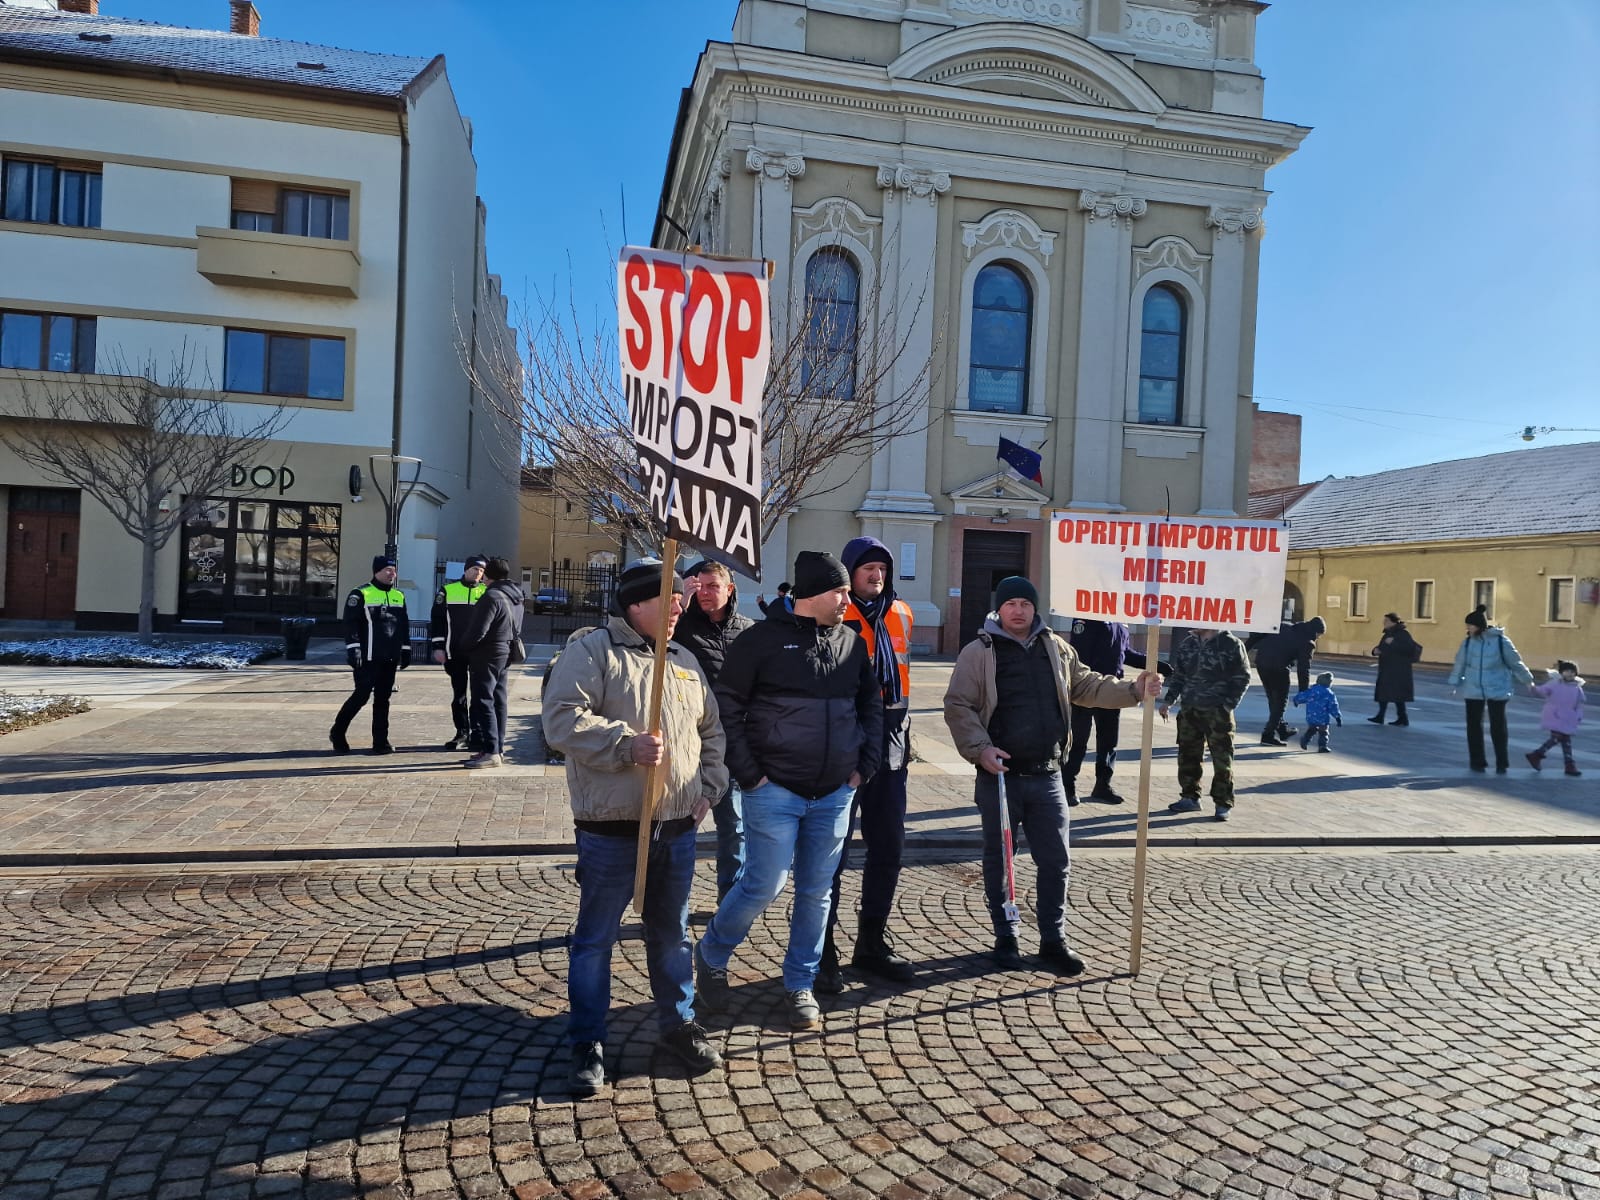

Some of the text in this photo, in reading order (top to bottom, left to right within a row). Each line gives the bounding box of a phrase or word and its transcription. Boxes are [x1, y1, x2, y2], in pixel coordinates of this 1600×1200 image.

[625, 254, 762, 404] STOP
[625, 373, 758, 487] IMPORT
[231, 463, 295, 495] DOP
[1058, 518, 1281, 552] OPRIȚI IMPORTUL
[1123, 557, 1206, 585] MIERII
[1076, 589, 1117, 615] DIN
[1123, 593, 1237, 624] UCRAINA
